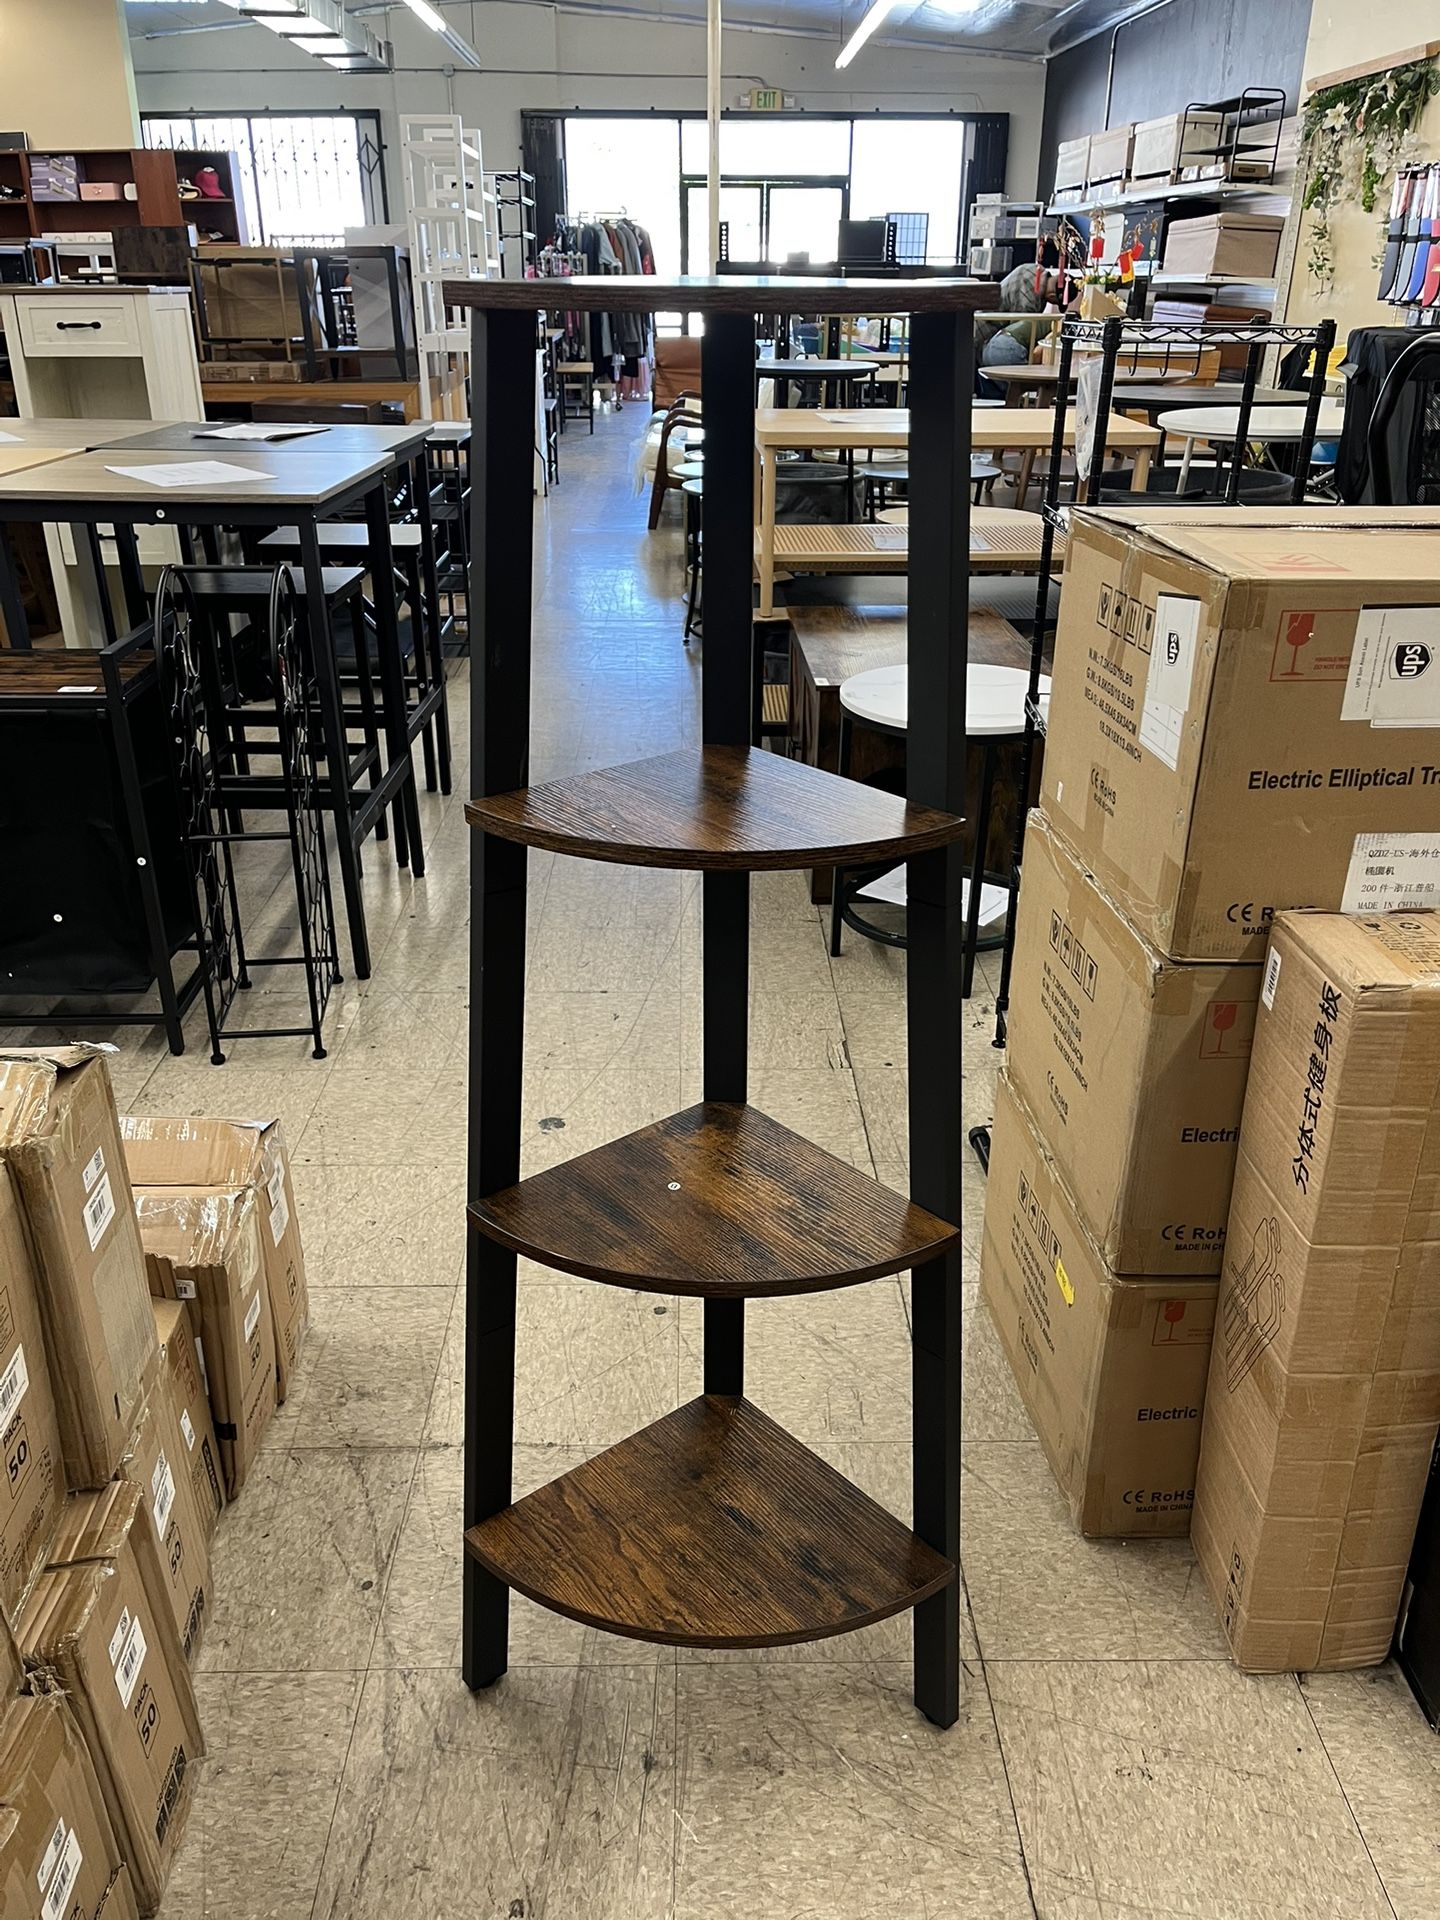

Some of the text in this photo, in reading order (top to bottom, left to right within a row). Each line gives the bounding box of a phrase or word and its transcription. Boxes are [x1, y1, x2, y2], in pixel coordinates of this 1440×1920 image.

[757, 91, 777, 108] EXIT
[1168, 633, 1179, 664] ups
[1400, 645, 1425, 676] ups
[1248, 766, 1440, 791] Electric Elliptical Tr
[1361, 884, 1377, 893] 200
[1358, 901, 1424, 910] MADE IN CHINA
[1242, 926, 1270, 936] MADE
[1292, 981, 1342, 1195] 分体式健身板
[1181, 1127, 1240, 1143] Electri
[1192, 1227, 1227, 1240] RoH
[1175, 1243, 1199, 1251] MADE
[1201, 1243, 1211, 1251] IN
[1137, 1406, 1198, 1422] Electric
[3, 1410, 22, 1450] PACK
[8, 1439, 28, 1483] 50
[1151, 1489, 1195, 1503] RoHS
[1135, 1505, 1159, 1513] MADE
[170, 1540, 182, 1576] 50
[133, 1680, 149, 1719] PACK
[142, 1702, 157, 1745] 50
